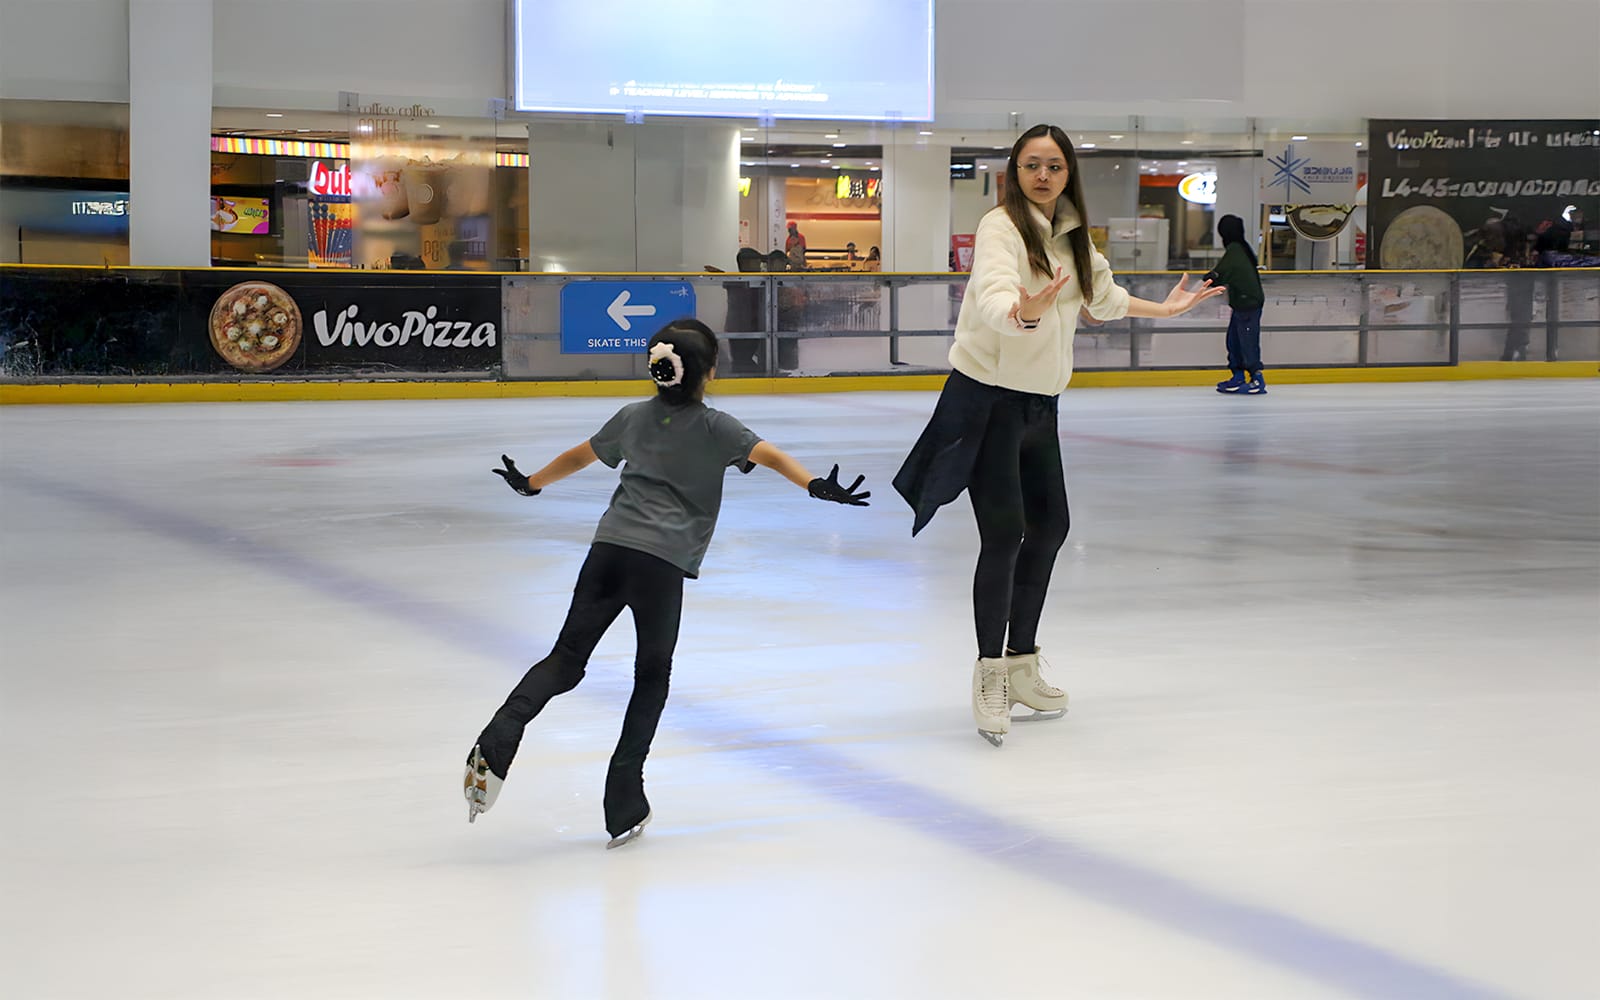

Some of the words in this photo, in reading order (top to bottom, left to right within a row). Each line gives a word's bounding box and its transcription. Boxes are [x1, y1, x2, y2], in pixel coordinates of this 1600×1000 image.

[313, 304, 497, 348] VivoPizza
[587, 338, 621, 348] SKATE
[624, 338, 647, 348] THIS
